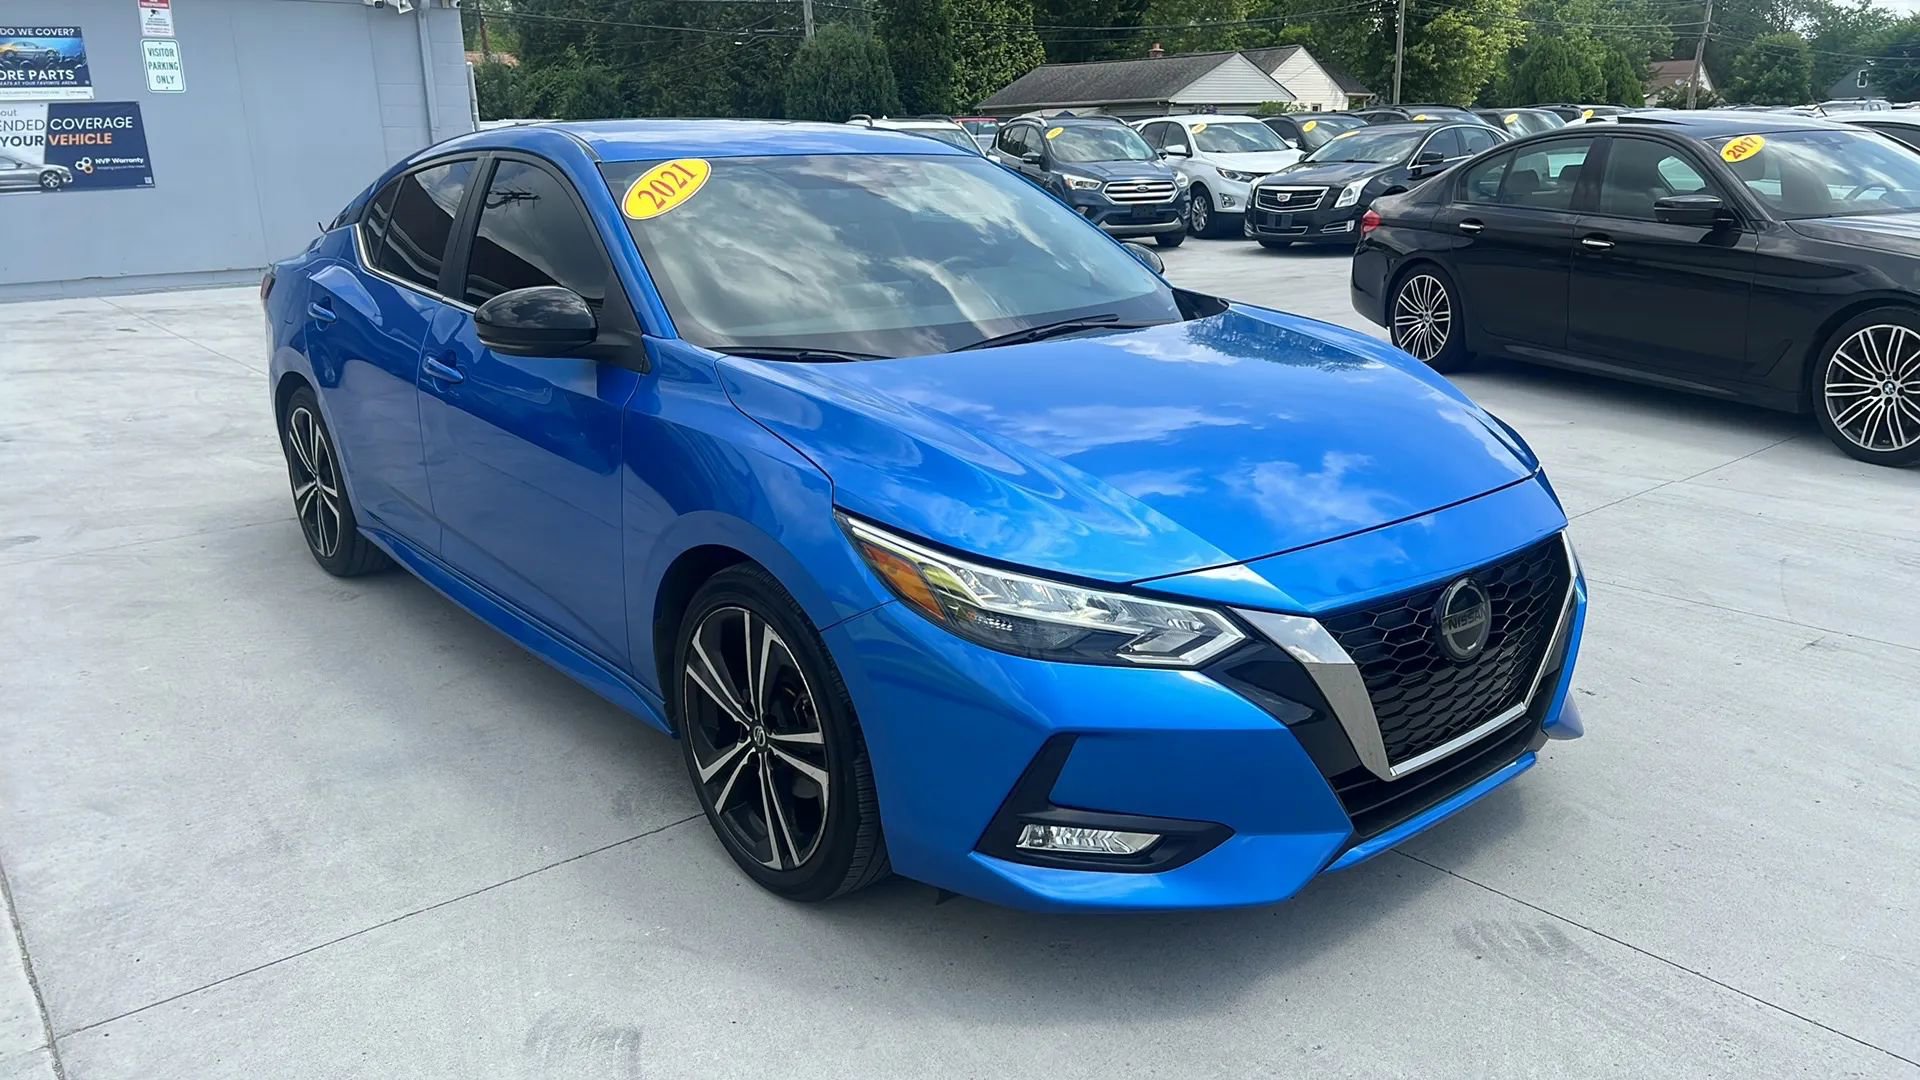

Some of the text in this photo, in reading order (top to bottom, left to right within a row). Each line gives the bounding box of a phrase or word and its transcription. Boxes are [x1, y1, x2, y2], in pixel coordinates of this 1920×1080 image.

[0, 28, 75, 36] DO WE COVER?
[147, 47, 175, 57] VISITOR
[148, 61, 179, 71] PARKING
[28, 69, 75, 81] PARTS
[156, 75, 175, 84] ONLY
[50, 116, 133, 130] COVERAGE
[0, 132, 113, 148] YOUR VEHICLE
[1726, 136, 1758, 160] 2017
[95, 156, 145, 165] NVP Warranty
[637, 163, 698, 210] 2021
[1448, 607, 1487, 630] NISSAN
